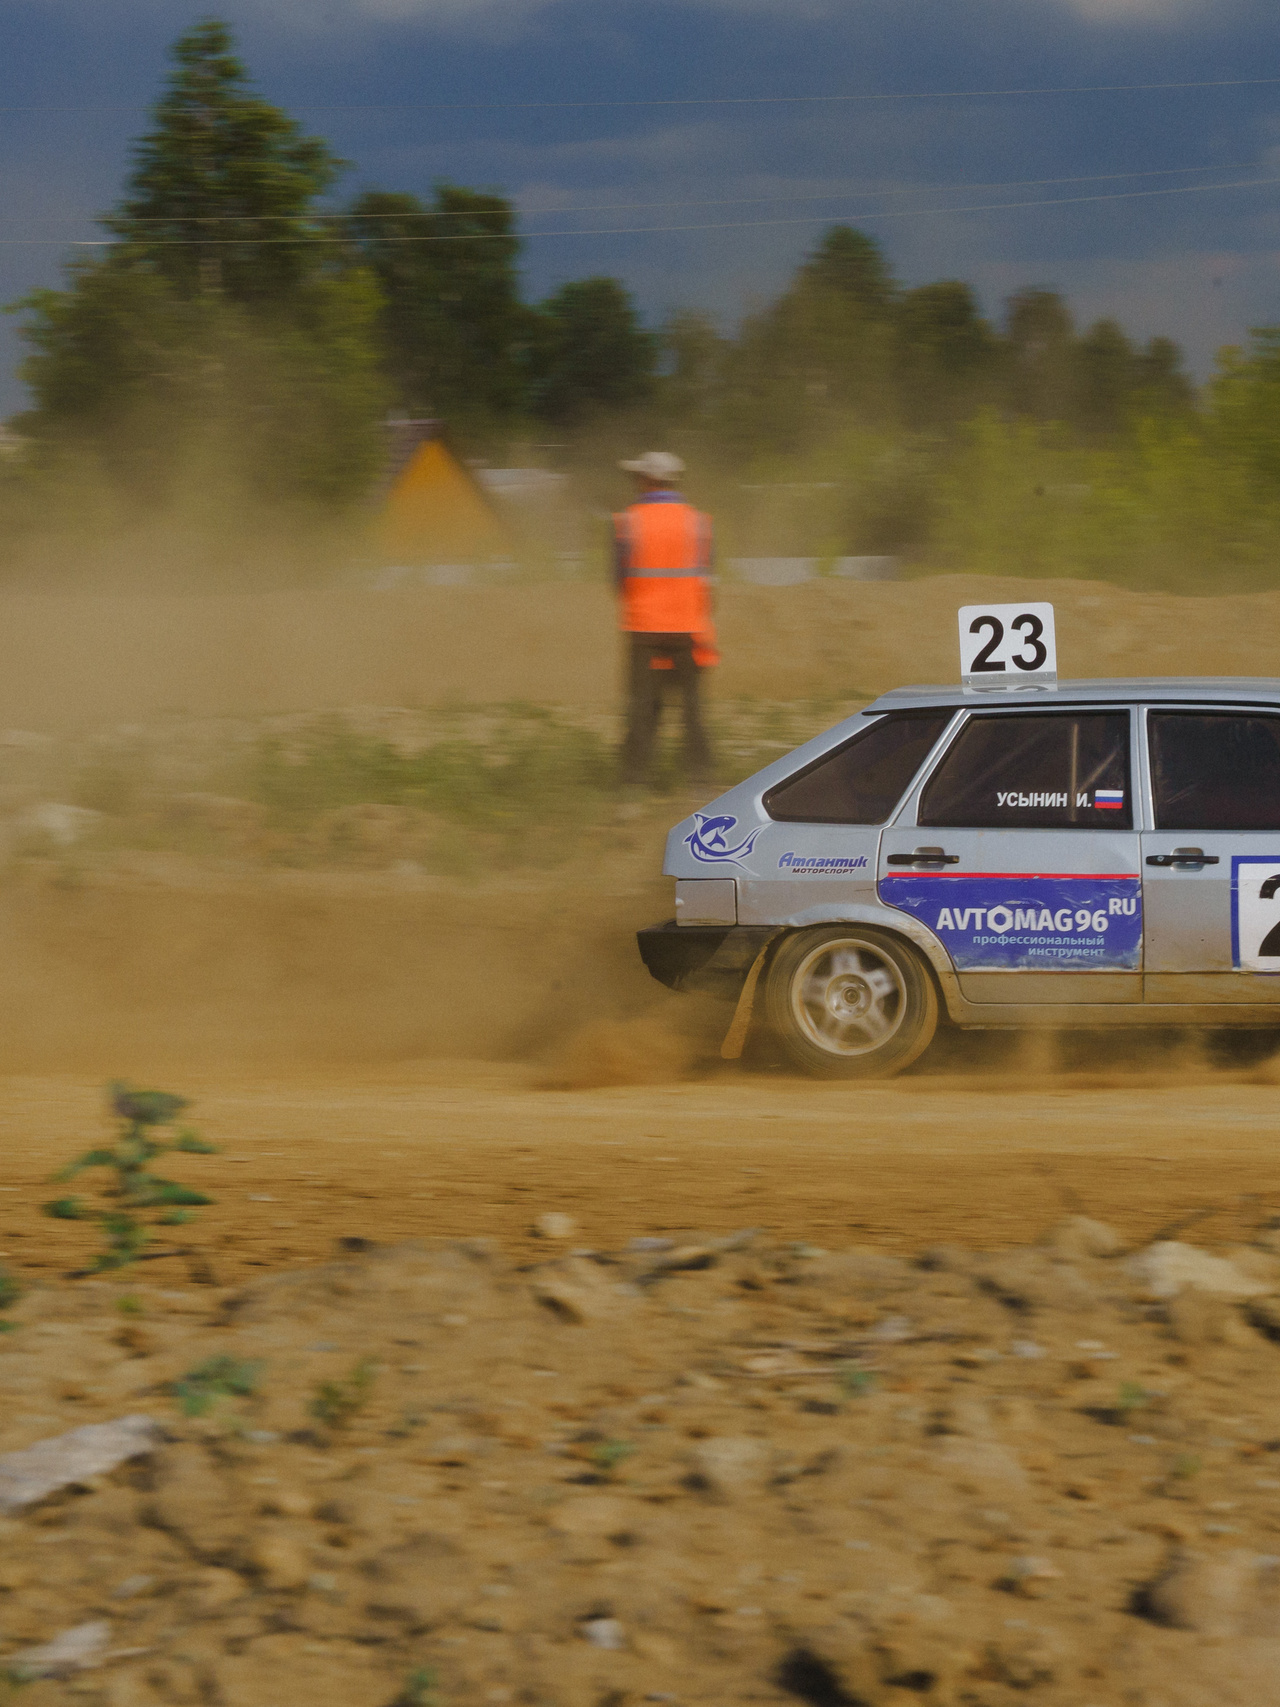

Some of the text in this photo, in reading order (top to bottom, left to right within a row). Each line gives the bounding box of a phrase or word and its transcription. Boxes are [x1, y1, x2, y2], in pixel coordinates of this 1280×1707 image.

[968, 613, 1047, 673] 23
[997, 792, 1092, 807] УСЫНИН И.
[778, 851, 869, 868] Атлантик
[792, 867, 855, 875] МОТОРСПОРТ
[1108, 898, 1137, 916] RU
[972, 934, 1105, 947] профессиональный
[1028, 947, 1106, 958] инструмент
